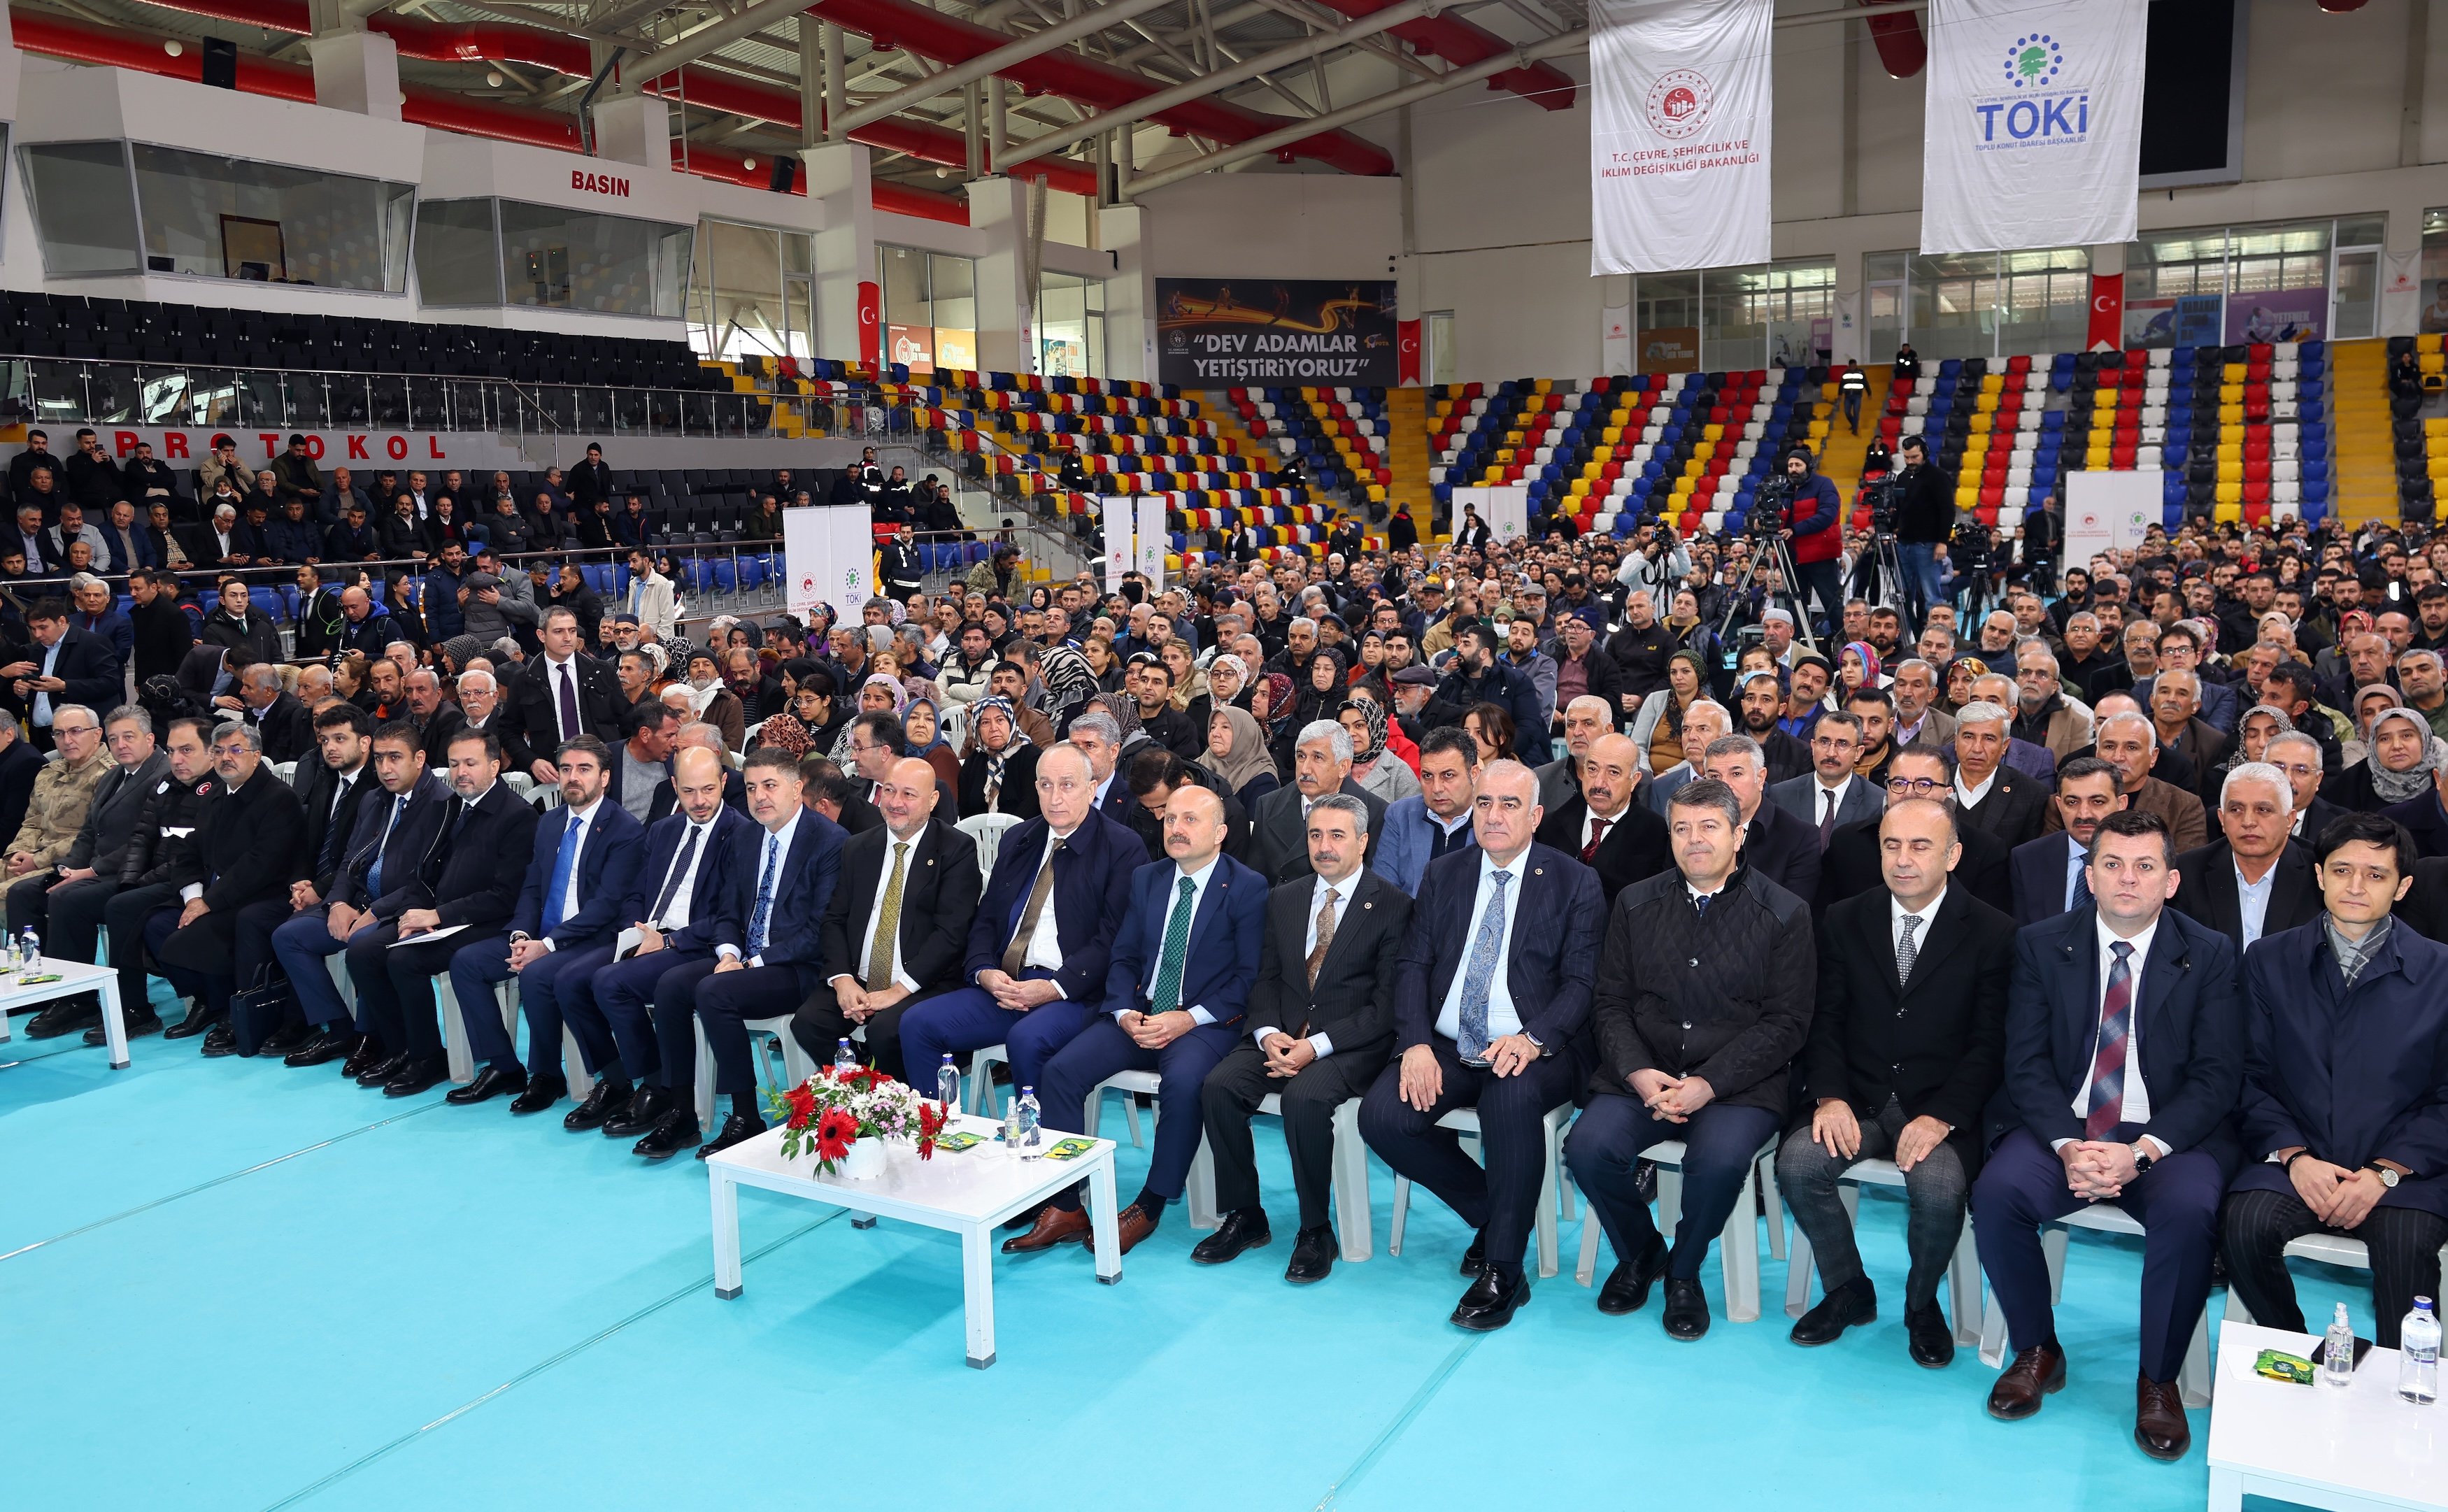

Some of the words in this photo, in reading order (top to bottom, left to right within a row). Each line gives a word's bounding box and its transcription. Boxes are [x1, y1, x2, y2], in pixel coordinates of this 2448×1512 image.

[1612, 153, 1631, 162] T.C.
[1633, 149, 1670, 163] ÇEVRE,
[1672, 141, 1732, 157] ŞEHİRCİLİK
[1735, 140, 1748, 149] VE
[2047, 135, 2086, 145] BAŞKANLIĞI
[1602, 167, 1630, 178] İKLİM
[1634, 159, 1697, 176] DEĞİŞİKLİĞİ
[1700, 152, 1759, 169] BAKANLIĞI
[571, 170, 629, 197] BASIN
[1254, 335, 1358, 352] ADAMLAR
